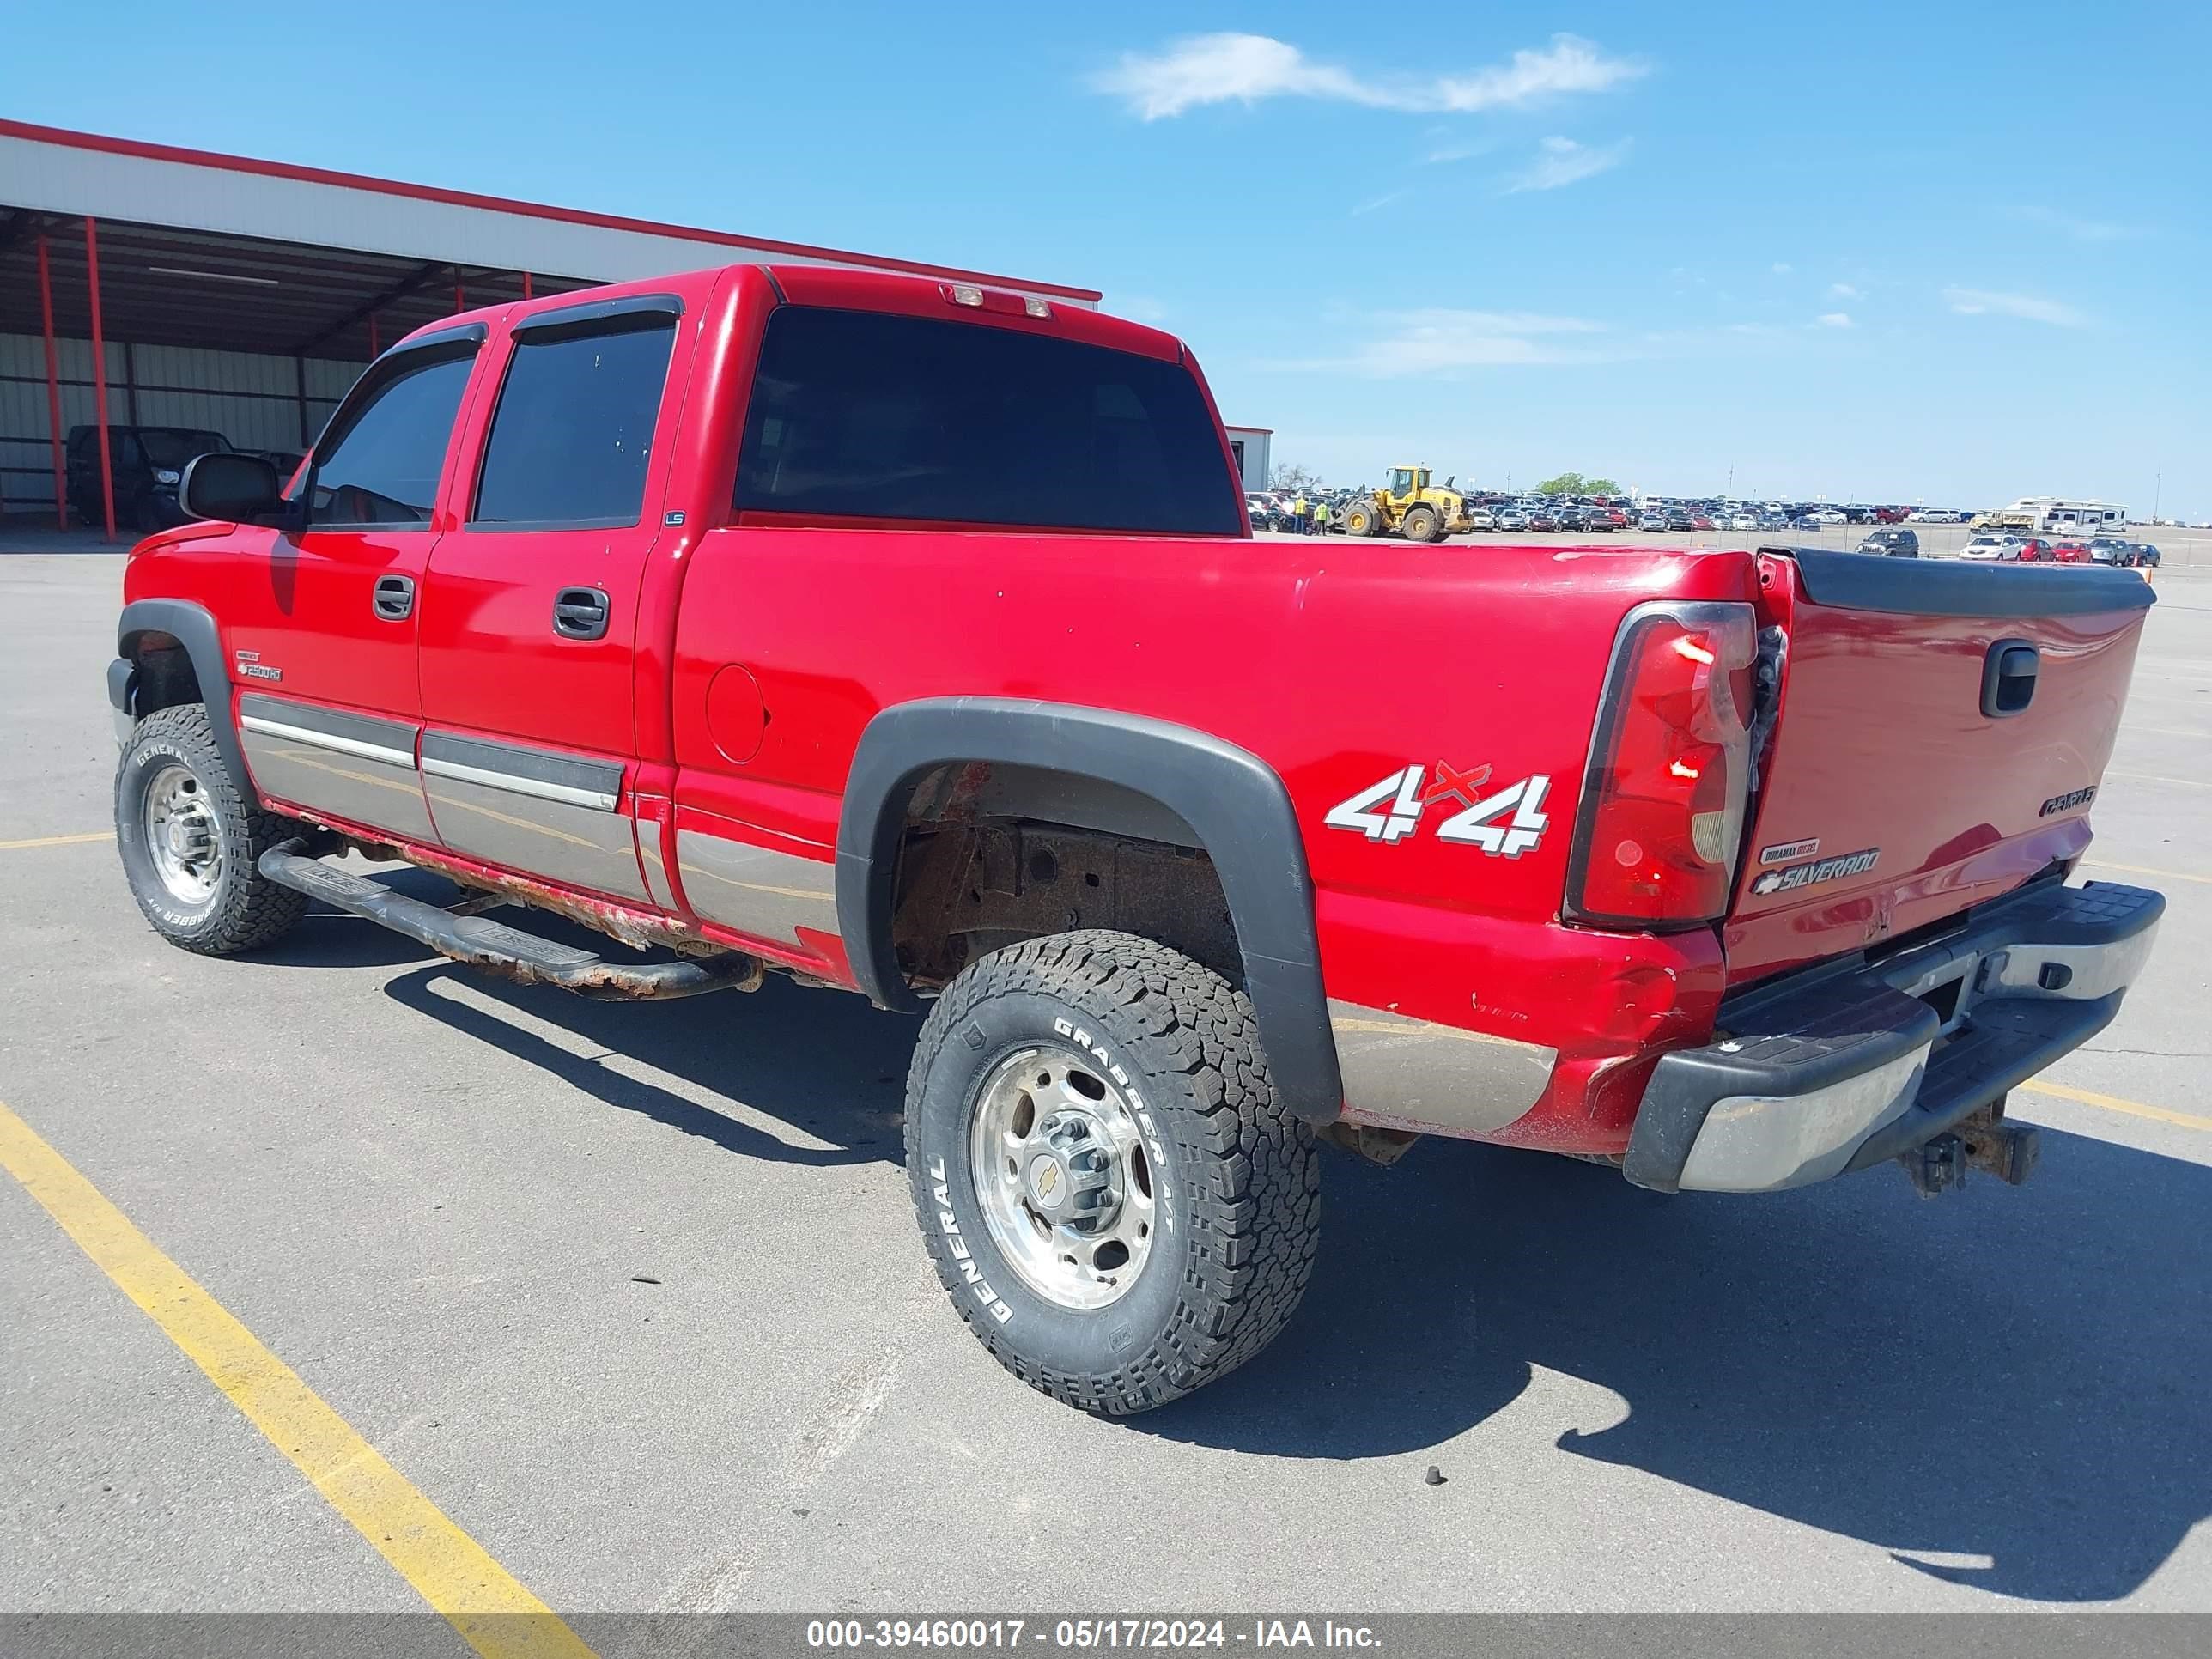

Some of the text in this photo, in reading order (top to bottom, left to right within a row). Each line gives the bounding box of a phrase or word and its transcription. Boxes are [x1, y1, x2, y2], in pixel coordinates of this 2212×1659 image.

[665, 514, 684, 524] LS
[137, 744, 192, 767] GENERAL
[1765, 843, 1816, 861] DURAMAX DIESEL
[1779, 851, 1881, 890] SILVERADO
[163, 896, 216, 926] GRABBER
[1054, 1016, 1166, 1167] GRABBER
[930, 1158, 1014, 1325] GENERAL
